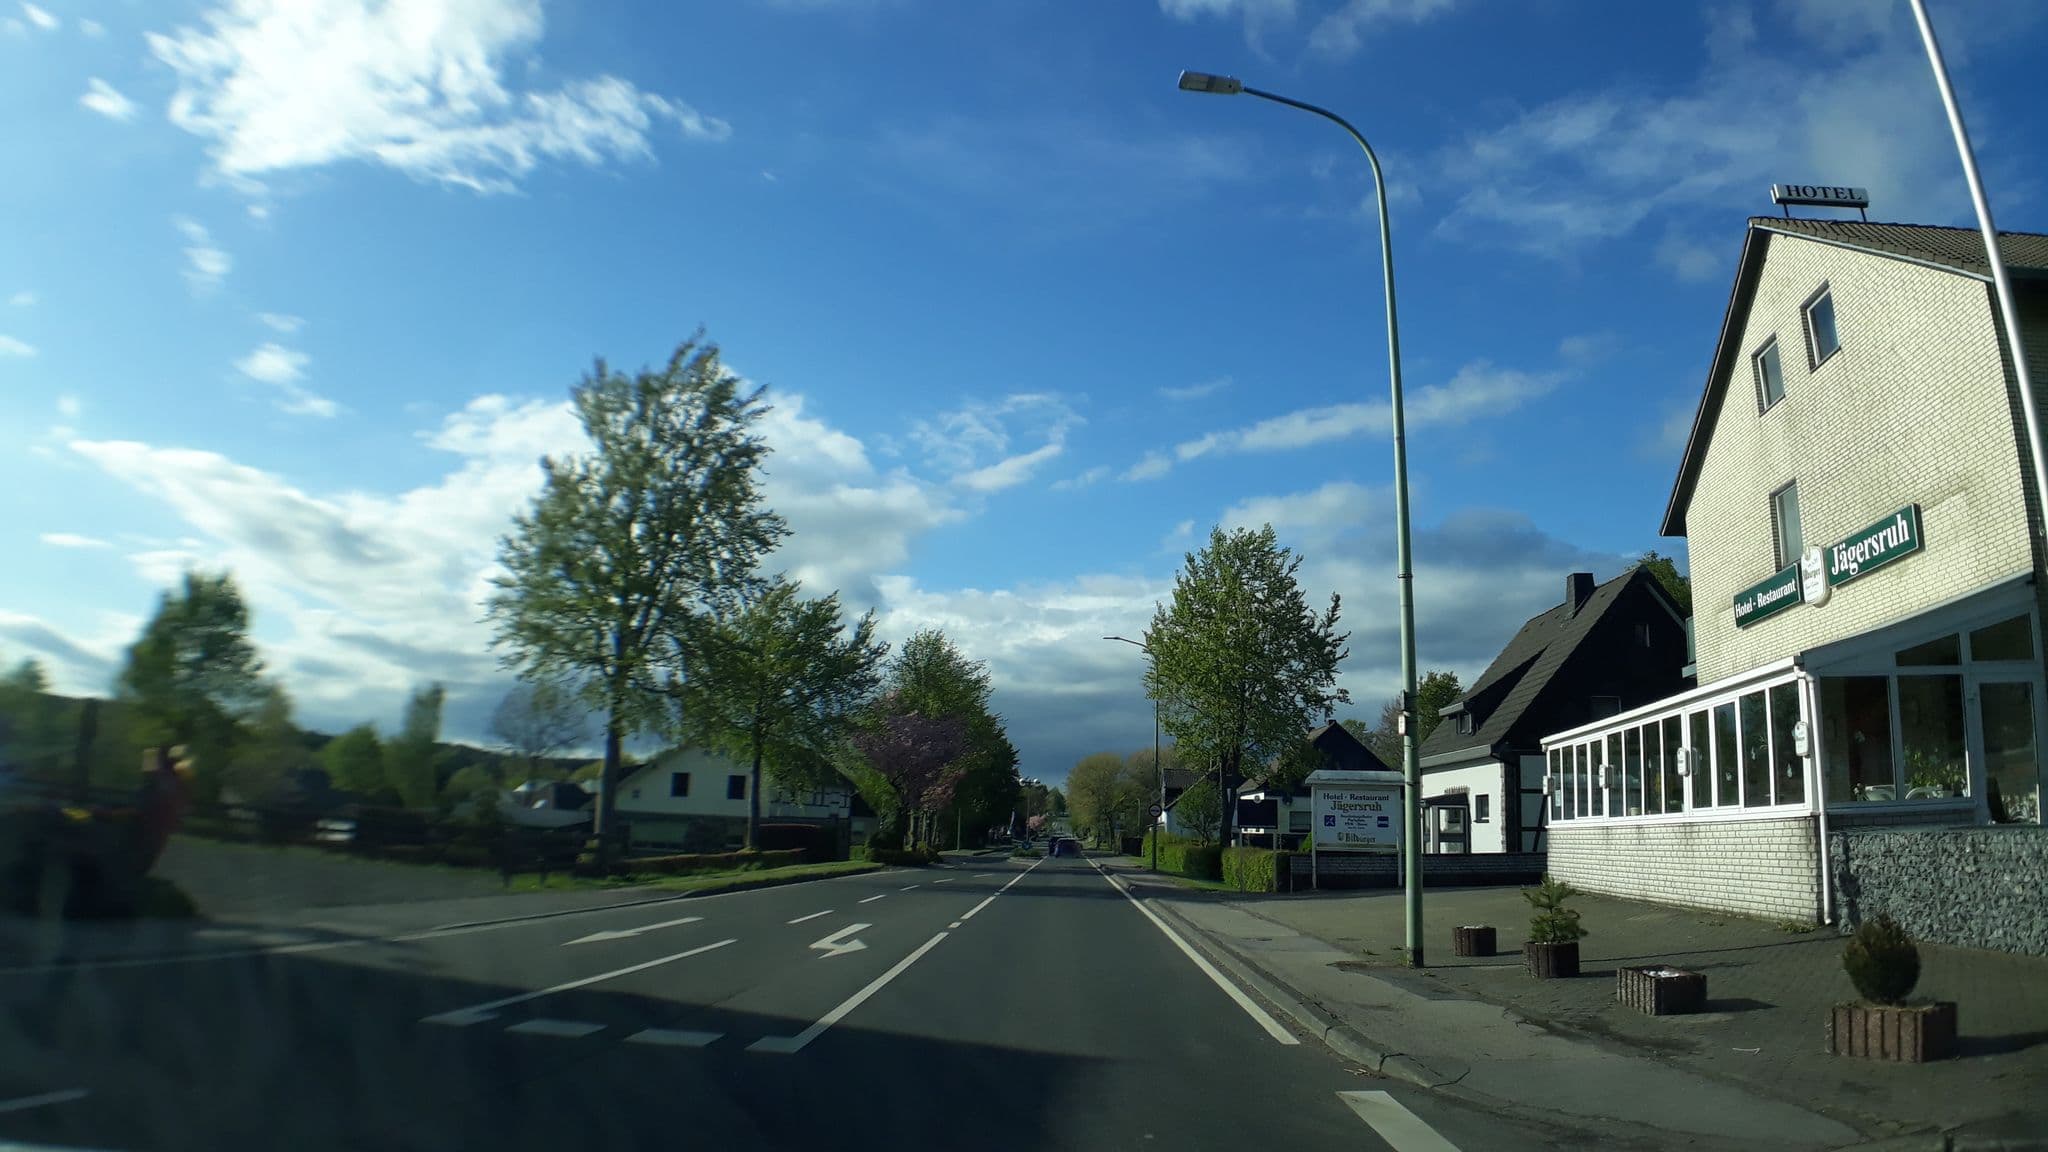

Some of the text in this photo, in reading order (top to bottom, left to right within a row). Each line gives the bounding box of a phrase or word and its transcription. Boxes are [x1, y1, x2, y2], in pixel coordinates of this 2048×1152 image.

[1785, 185, 1862, 201] HOTEL
[1831, 513, 1910, 575] Jägersruh
[1735, 597, 1754, 619] Hotel
[1757, 578, 1797, 608] Restaurant
[1323, 792, 1344, 801] Hotel
[1349, 793, 1390, 802] Restaurant
[1330, 800, 1382, 813] Jägersruh
